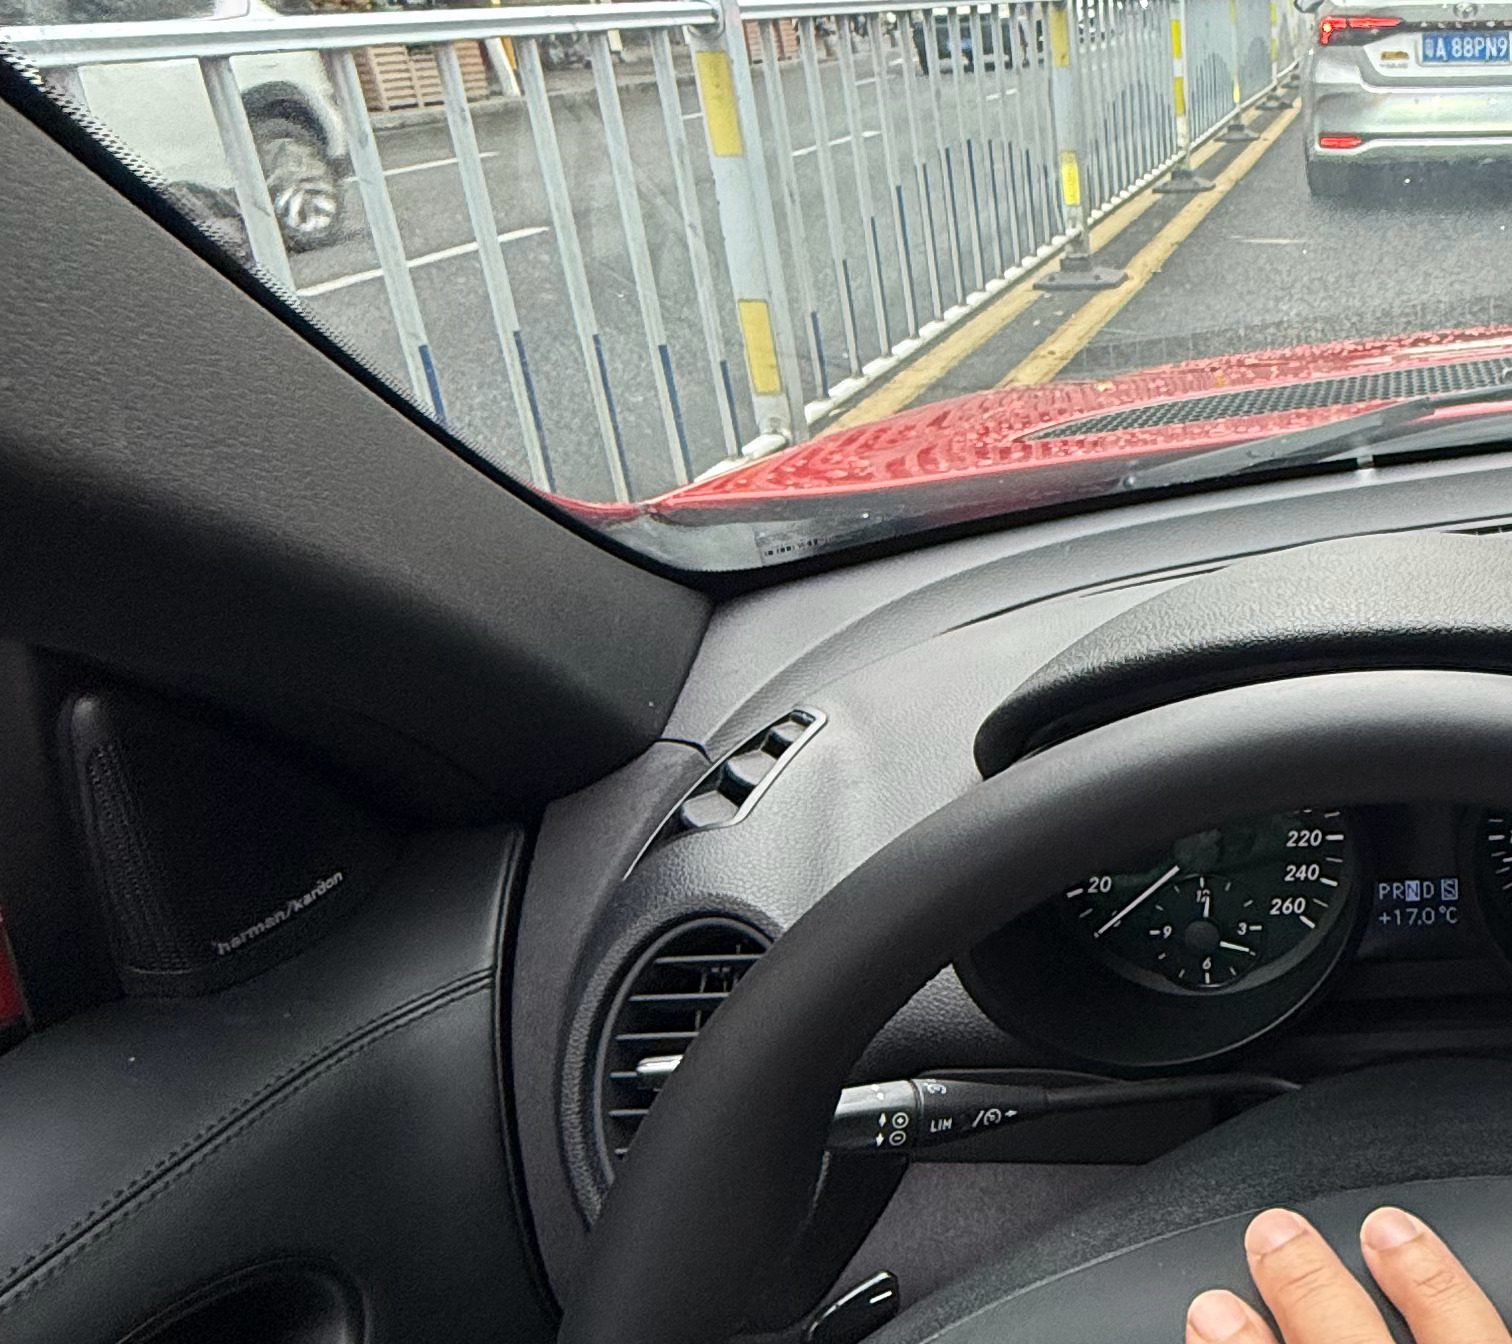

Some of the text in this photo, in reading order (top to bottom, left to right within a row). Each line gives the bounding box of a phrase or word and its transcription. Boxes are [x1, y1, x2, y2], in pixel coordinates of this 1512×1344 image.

[1286, 829, 1323, 848] 220
[1284, 863, 1320, 882] 240
[1087, 875, 1112, 894] 20
[212, 872, 343, 955] harman/kardon
[1269, 897, 1307, 916] 260
[1162, 925, 1173, 939] 9
[1237, 921, 1248, 936] 3
[1202, 957, 1212, 970] 6
[930, 1118, 953, 1133] LIM
